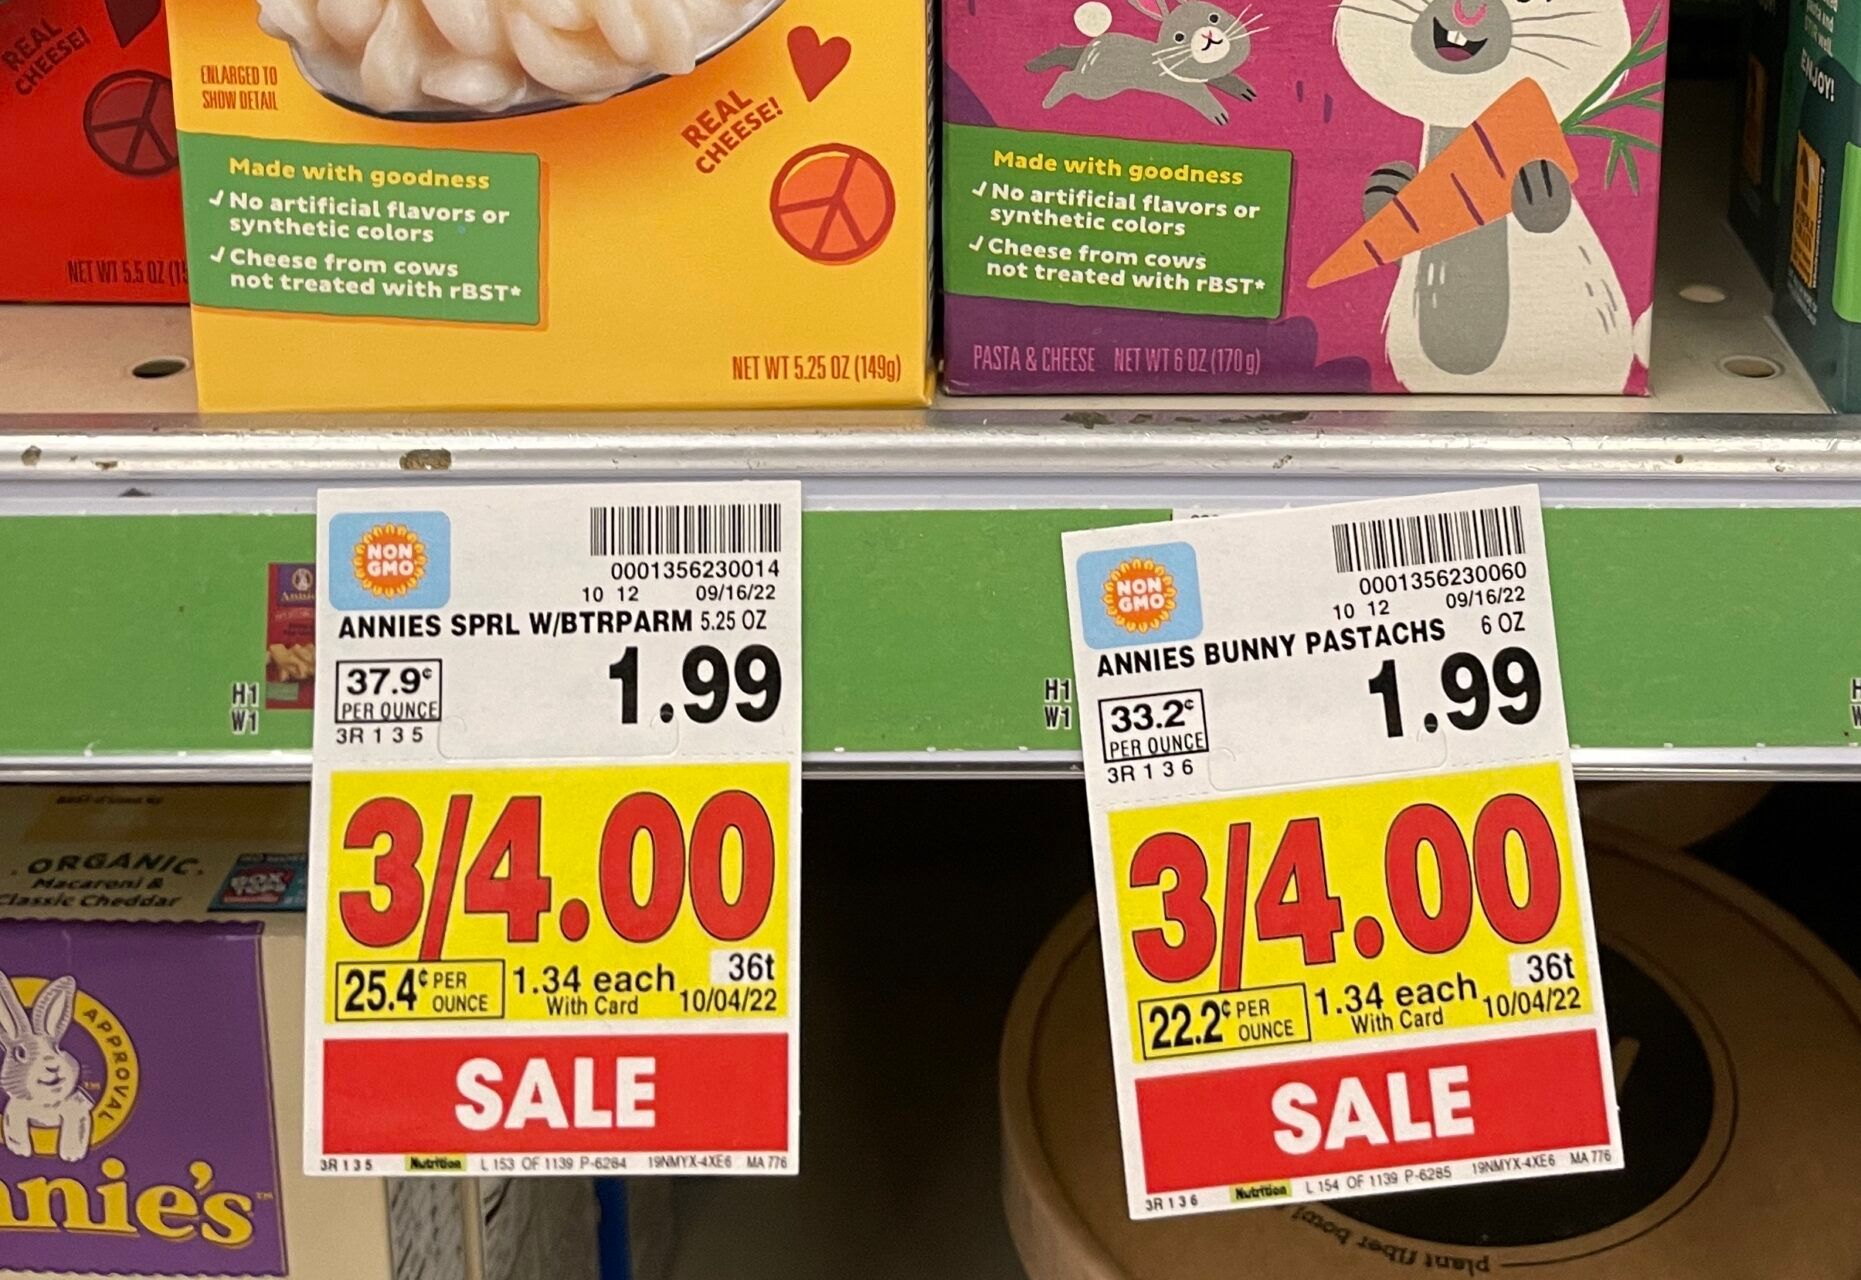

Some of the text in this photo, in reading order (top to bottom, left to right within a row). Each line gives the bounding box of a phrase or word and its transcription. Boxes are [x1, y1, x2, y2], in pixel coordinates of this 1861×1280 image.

[1, 19, 63, 72] REAL
[200, 64, 278, 86] ENLARGED TO
[1801, 48, 1835, 102] ENJOY!
[202, 89, 279, 112] SHOW DETAIL
[681, 89, 754, 150] REAL
[695, 96, 783, 174] CHEESE!
[229, 157, 490, 190] Made with goodness
[993, 150, 1244, 185] Made with goodness
[229, 191, 510, 224] No artificial flavors or
[992, 182, 1260, 220] No artificial flavors or
[229, 216, 435, 243] synthetic colors
[990, 205, 1186, 236] synthetic colors
[230, 248, 459, 277] Cheese from cows
[988, 237, 1207, 271] Cheese from cows
[230, 272, 274, 290] not
[279, 273, 375, 296] treated
[382, 278, 443, 299] with
[986, 261, 1028, 279] not
[1034, 262, 1125, 287] treated
[1132, 272, 1189, 291] with
[732, 354, 902, 383] NET WT 5.25 OZ (149g)
[973, 344, 1207, 373] PASTA & CHEESE NET WT 6 OZ
[367, 543, 413, 561] NON
[367, 559, 415, 578] GMO
[611, 559, 780, 581] 0001356230014
[1359, 561, 1527, 596] 0001356230060
[695, 584, 777, 603] 09/16/22
[1117, 576, 1163, 597] NON
[1445, 586, 1526, 610] 09/16/22
[1118, 592, 1166, 613] GMO
[338, 614, 441, 639] ANNIES
[450, 613, 520, 637] SPRL
[528, 609, 693, 639] W/BTRPARM
[700, 611, 736, 632] 5.25
[741, 610, 768, 631] OZ
[1096, 612, 1526, 678] ANNIES BUNNY PASTACHS 6 OZ
[232, 682, 259, 705] H1
[608, 643, 782, 725] 1.99
[1045, 678, 1070, 701] H1
[1367, 645, 1542, 740] 1.99
[231, 710, 259, 733] W1
[341, 701, 439, 720] PER OUNCE
[1044, 706, 1070, 728] W1
[1108, 731, 1206, 760] PER OUNCE
[31, 877, 142, 890] Macaroni
[338, 790, 777, 962] 3/4.00
[80, 894, 182, 908] Cheddar
[1128, 793, 1563, 993] 3/4.00
[433, 972, 467, 989] PER
[513, 964, 676, 994] 1.34 each
[728, 953, 775, 982] 36t
[1527, 953, 1575, 984] 36t
[432, 995, 488, 1013] OUNCE
[547, 995, 639, 1016] With Card
[679, 987, 777, 1014] 10/04/22
[1236, 998, 1270, 1018] PER
[1314, 972, 1478, 1017] 1.34 each
[1482, 985, 1582, 1020] 10/04/22
[1238, 1019, 1295, 1043] OUNCE
[1351, 1008, 1444, 1034] With Card
[84, 1008, 130, 1121] APPROVAL
[454, 1056, 656, 1131] SALE
[1270, 1064, 1475, 1156] SALE
[410, 1157, 462, 1170] Nutrition
[1235, 1185, 1288, 1200] Nutrition
[1404, 1165, 1452, 1184] P-6285
[1357, 1236, 1418, 1266] fiber
[1425, 1255, 1490, 1276] plant
